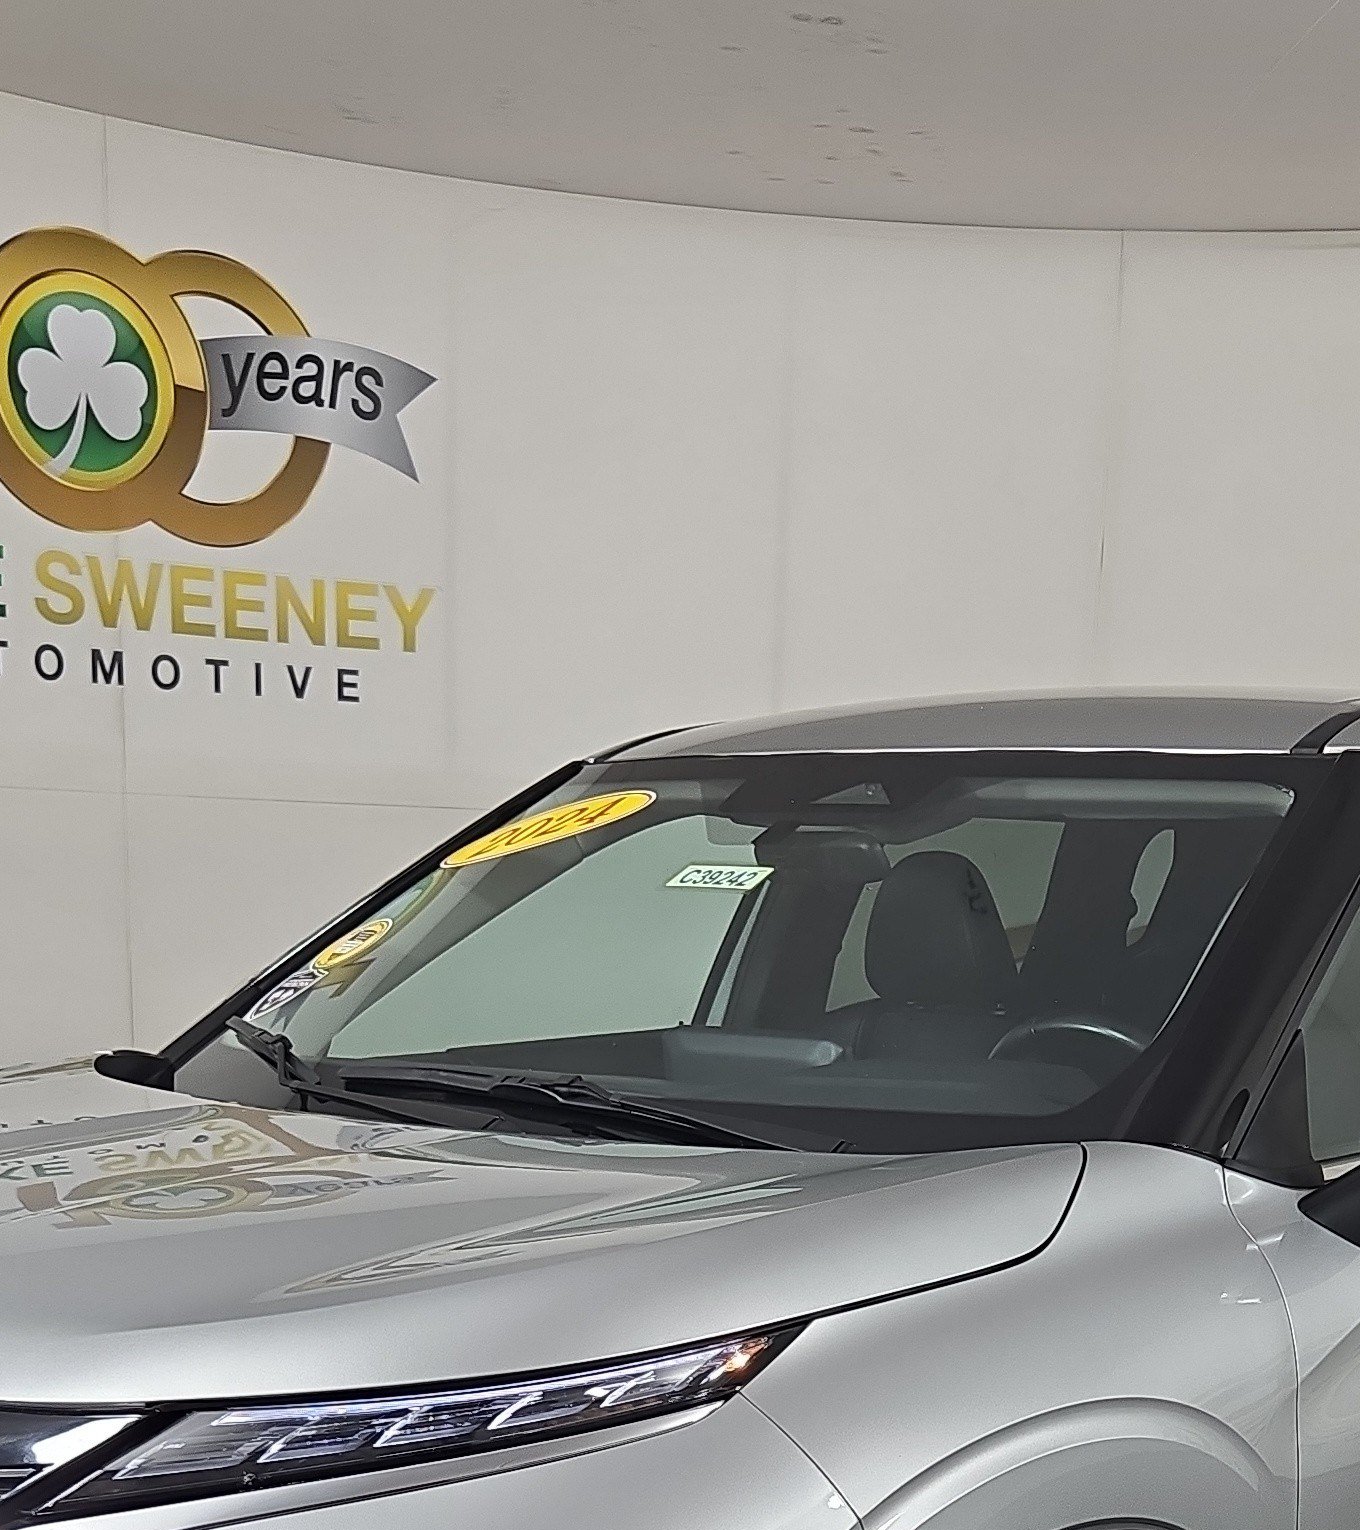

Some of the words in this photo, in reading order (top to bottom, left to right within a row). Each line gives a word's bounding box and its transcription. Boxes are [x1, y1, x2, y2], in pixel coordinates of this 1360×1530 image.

[220, 350, 384, 421] years
[34, 549, 436, 653] SWEENEY
[465, 797, 628, 860] 2024
[679, 869, 759, 887] C39242
